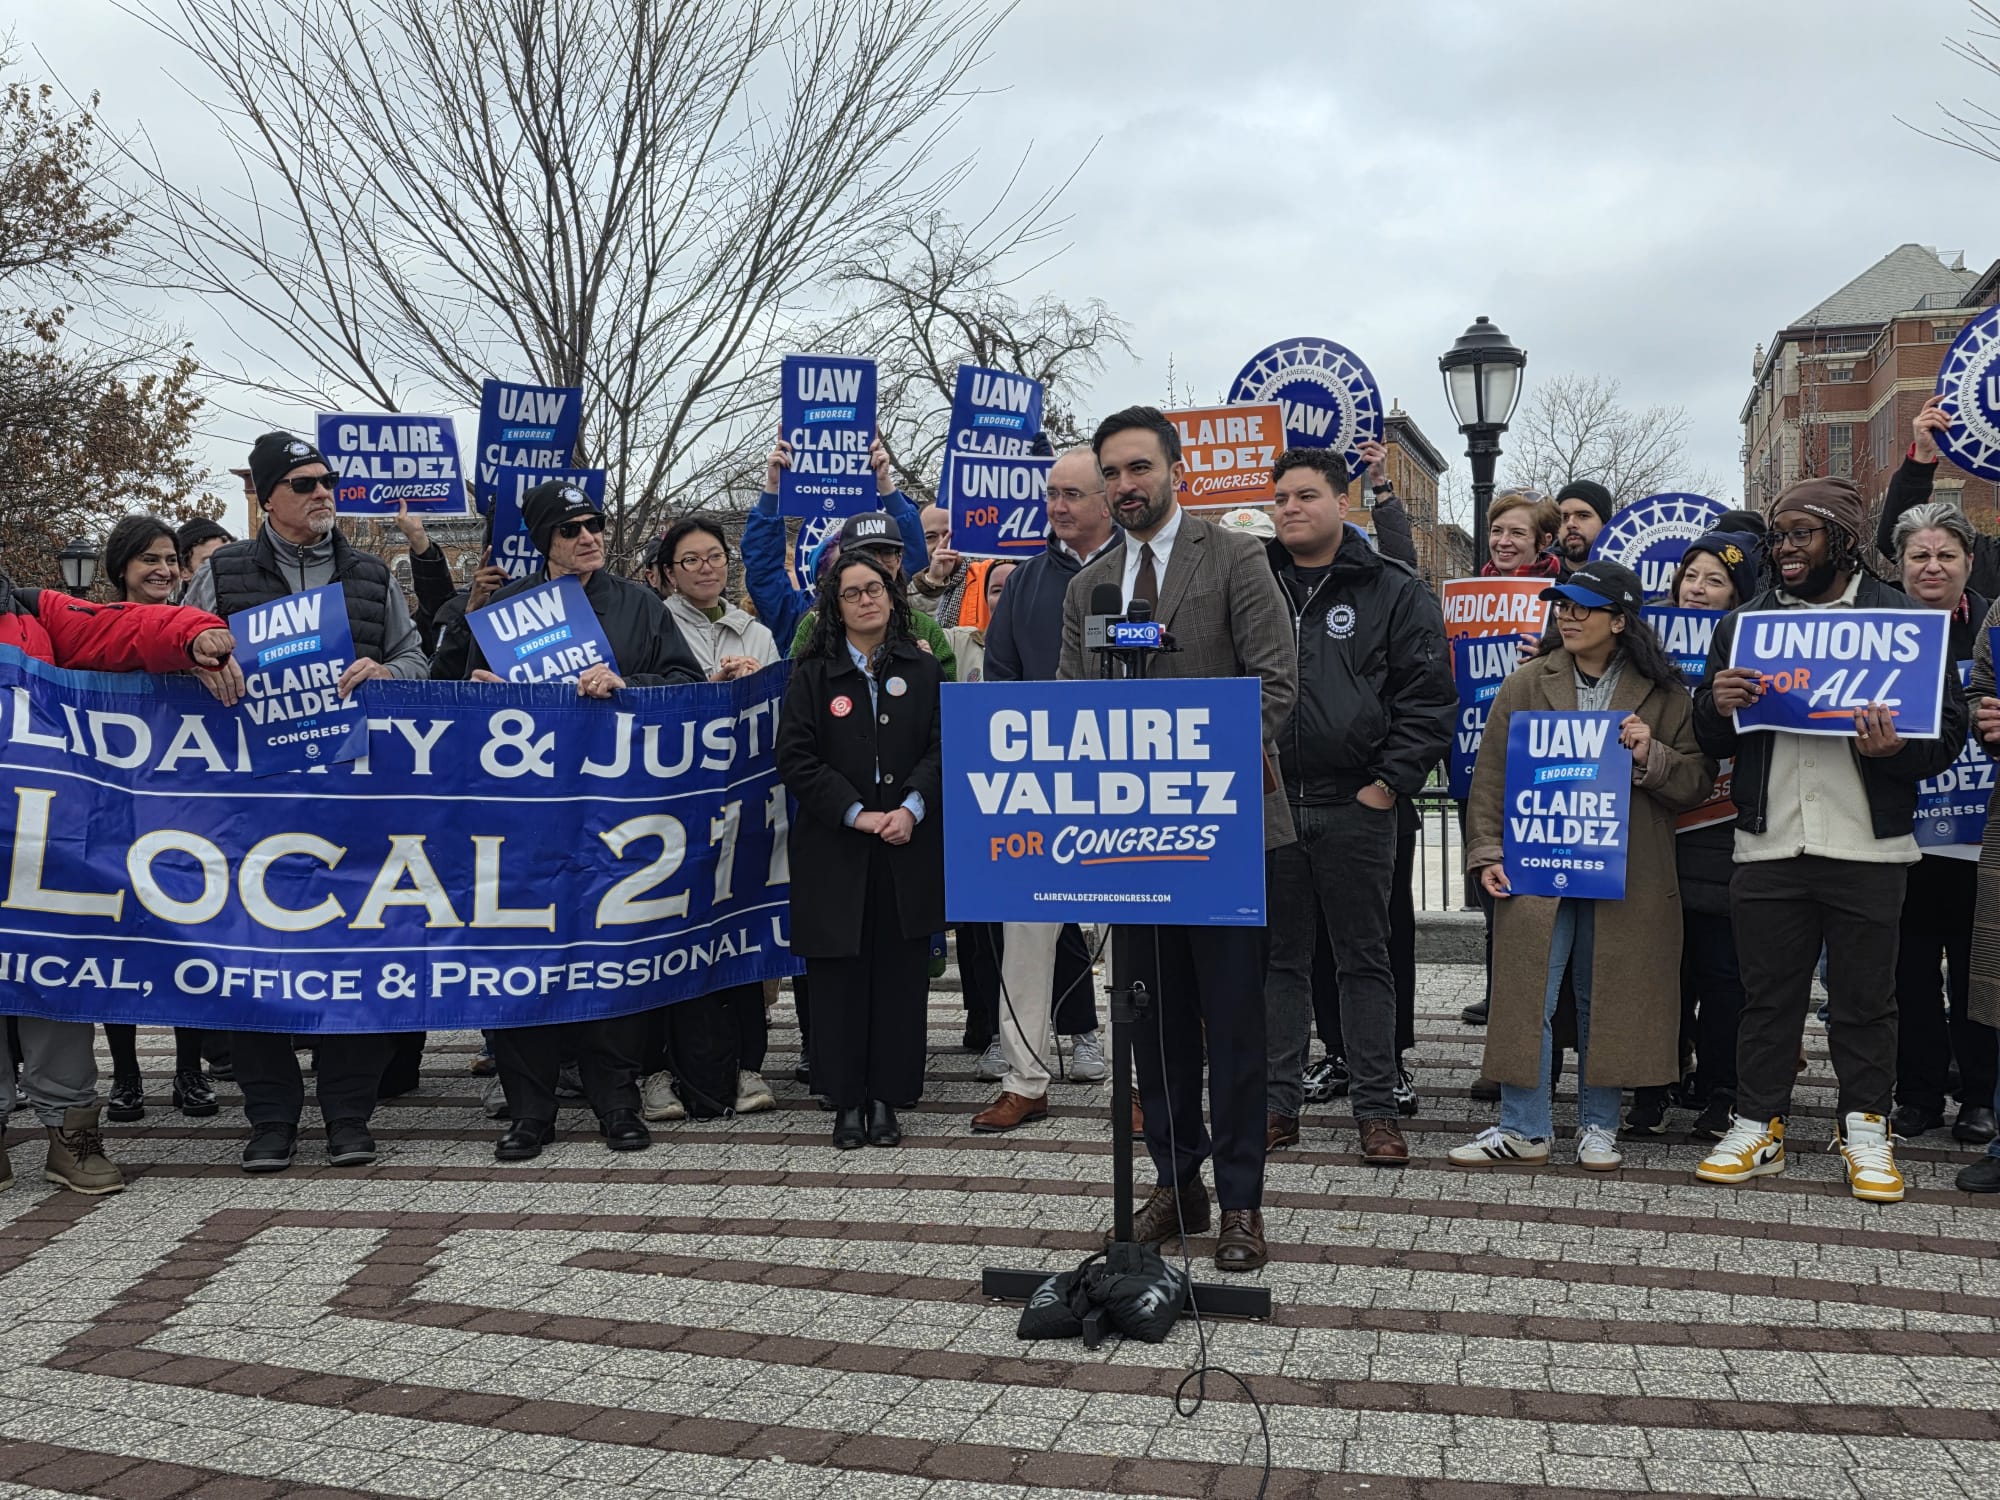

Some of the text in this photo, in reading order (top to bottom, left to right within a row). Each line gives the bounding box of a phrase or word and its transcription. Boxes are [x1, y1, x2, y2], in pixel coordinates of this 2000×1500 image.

[798, 367, 862, 403] UAW
[1286, 368, 1315, 377] AMERICA
[1316, 370, 1338, 387] UNITED
[498, 387, 567, 425] UAW
[971, 373, 1032, 413] UAW
[809, 410, 852, 420] ENDORSES
[978, 416, 1020, 427] ENDORSES
[338, 424, 444, 452] CLAIRE
[507, 430, 551, 440] ENDORSES
[790, 428, 869, 452] CLAIRE
[957, 428, 1035, 457] CLAIRE
[1171, 416, 1263, 446] LAIRE
[327, 455, 457, 479] VALDEZ
[486, 444, 565, 469] CLAIRE
[786, 452, 872, 475] VALDEZ
[340, 483, 451, 504] FOR CONGRESS
[795, 485, 863, 496] CONGRESS
[1191, 471, 1270, 496] CONGRESS
[857, 519, 886, 536] UAW
[965, 505, 1052, 538] FOR AL
[1646, 525, 1679, 538] AMERICA
[1641, 560, 1681, 592] UA
[248, 593, 322, 644] UAW
[488, 585, 566, 642] UAW
[1444, 593, 1541, 623] MEDICARE
[520, 630, 567, 655] ENDORSES
[1647, 614, 1721, 655] UAW
[1754, 621, 1921, 663] UNIONS
[264, 640, 316, 662] ENDORSES
[509, 640, 603, 684] CLAIRE
[1468, 640, 1523, 679] UAW
[246, 658, 345, 699] CLAIRE
[1759, 668, 1901, 708] FOR ALL
[244, 687, 358, 725] VALDEZ
[0, 687, 454, 775] LIDATY
[480, 709, 555, 778] &
[267, 723, 350, 747] CONGRESS
[296, 719, 317, 729] FOR
[989, 708, 1210, 762] CLAIRE
[1529, 719, 1610, 758] UAW
[1541, 767, 1593, 780] ENDORSES
[1917, 764, 1996, 795] LDEZ
[966, 771, 1237, 814] VALDEZ
[1516, 789, 1616, 818] CLAIRE
[991, 825, 1220, 864] FOR CONGRESS
[1510, 817, 1620, 846] VALDEZ
[1, 786, 556, 934] LOCAL
[1521, 857, 1605, 870] CONGRESS
[1033, 892, 1171, 903] CLAIREVALDEZFORCONGRESS.COM
[174, 958, 362, 1000] OFFICE
[377, 963, 415, 999] &
[431, 928, 762, 997] PROFESSIONAL
